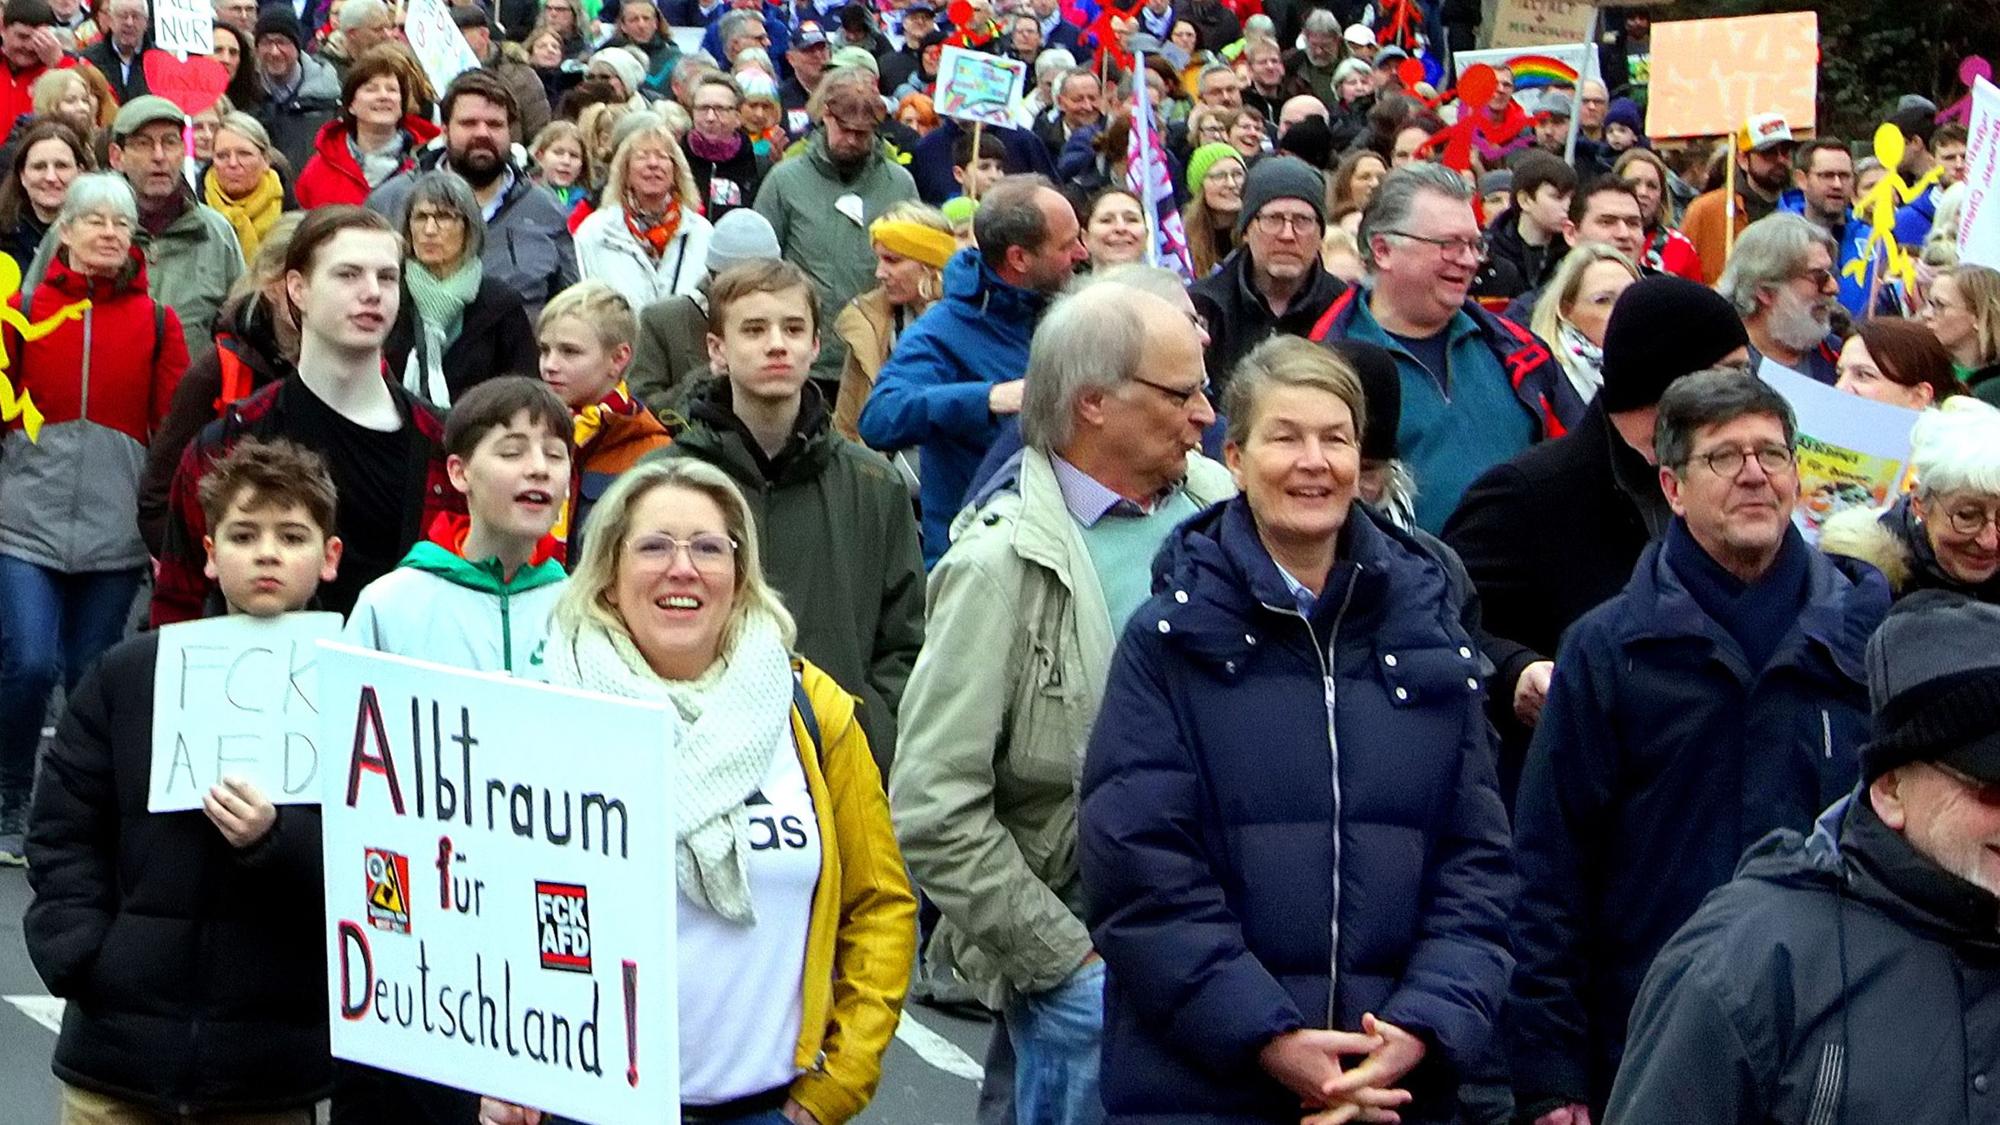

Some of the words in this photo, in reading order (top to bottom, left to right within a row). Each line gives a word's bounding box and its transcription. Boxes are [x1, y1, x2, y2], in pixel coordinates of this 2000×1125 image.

[160, 15, 209, 50] NUR
[181, 639, 319, 715] FCK
[345, 684, 629, 859] Albtraum
[435, 834, 486, 917] für
[537, 892, 588, 929] FCK
[541, 921, 591, 958] AFD
